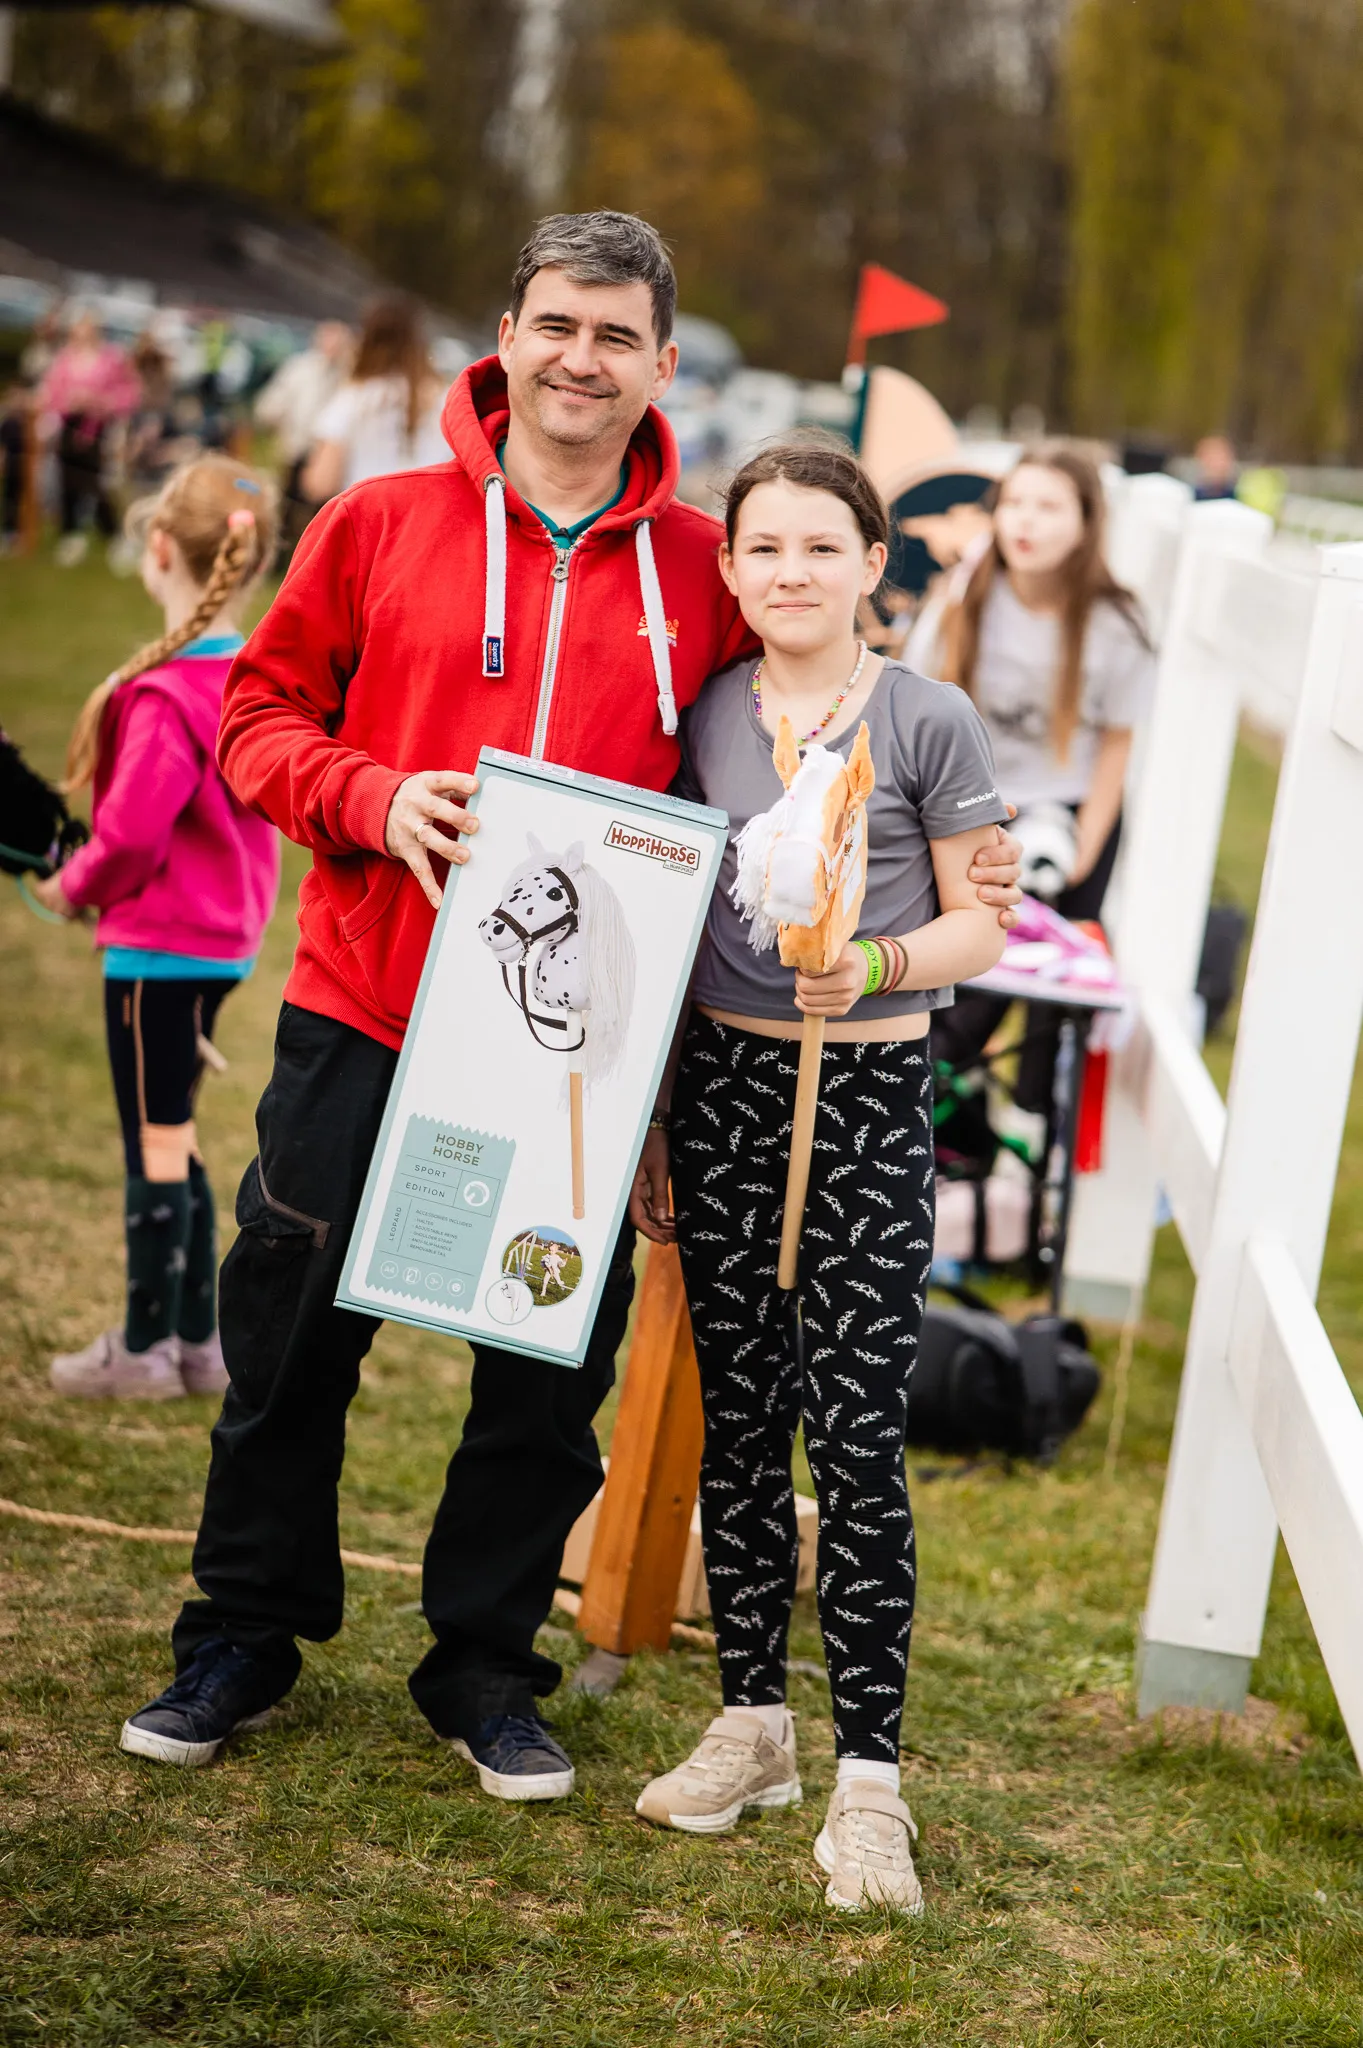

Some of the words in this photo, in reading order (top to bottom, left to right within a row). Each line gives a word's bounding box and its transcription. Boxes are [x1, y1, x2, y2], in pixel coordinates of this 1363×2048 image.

[436, 1133, 484, 1153] HOBBY
[432, 1146, 480, 1166] HORSE
[414, 1165, 446, 1178] SPORT
[405, 1182, 445, 1198] EDITION
[389, 1207, 402, 1241] LEOPARD
[449, 1218, 473, 1228] INCLUDED
